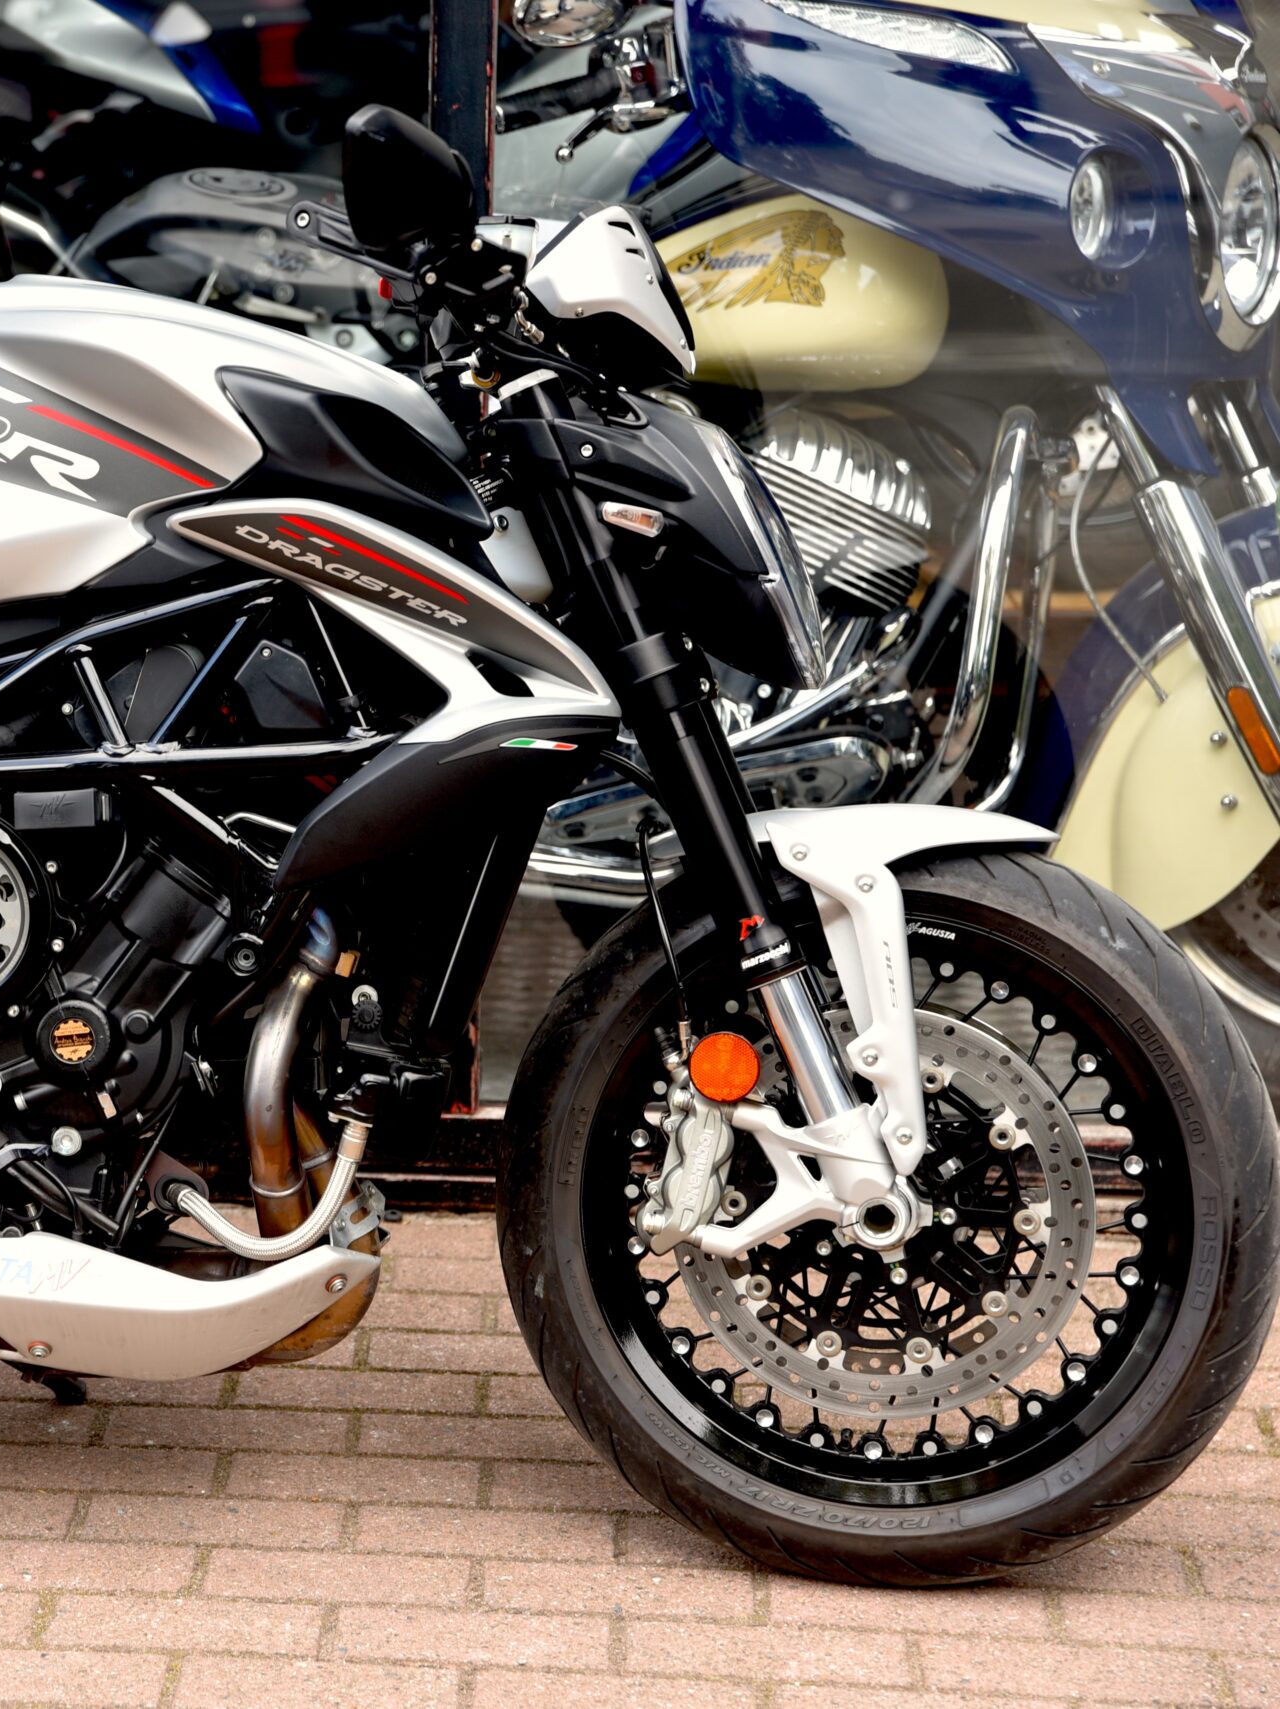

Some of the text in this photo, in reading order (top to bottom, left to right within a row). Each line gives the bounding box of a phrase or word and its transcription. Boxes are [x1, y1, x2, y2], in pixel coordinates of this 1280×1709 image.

[677, 240, 772, 275] Indian
[235, 524, 468, 627] DRAGSTER
[919, 926, 956, 941] AGUSTA
[1130, 1016, 1206, 1144] DIABLO
[1190, 1195, 1218, 1311] ROSSO
[822, 1511, 932, 1530] 120/70
